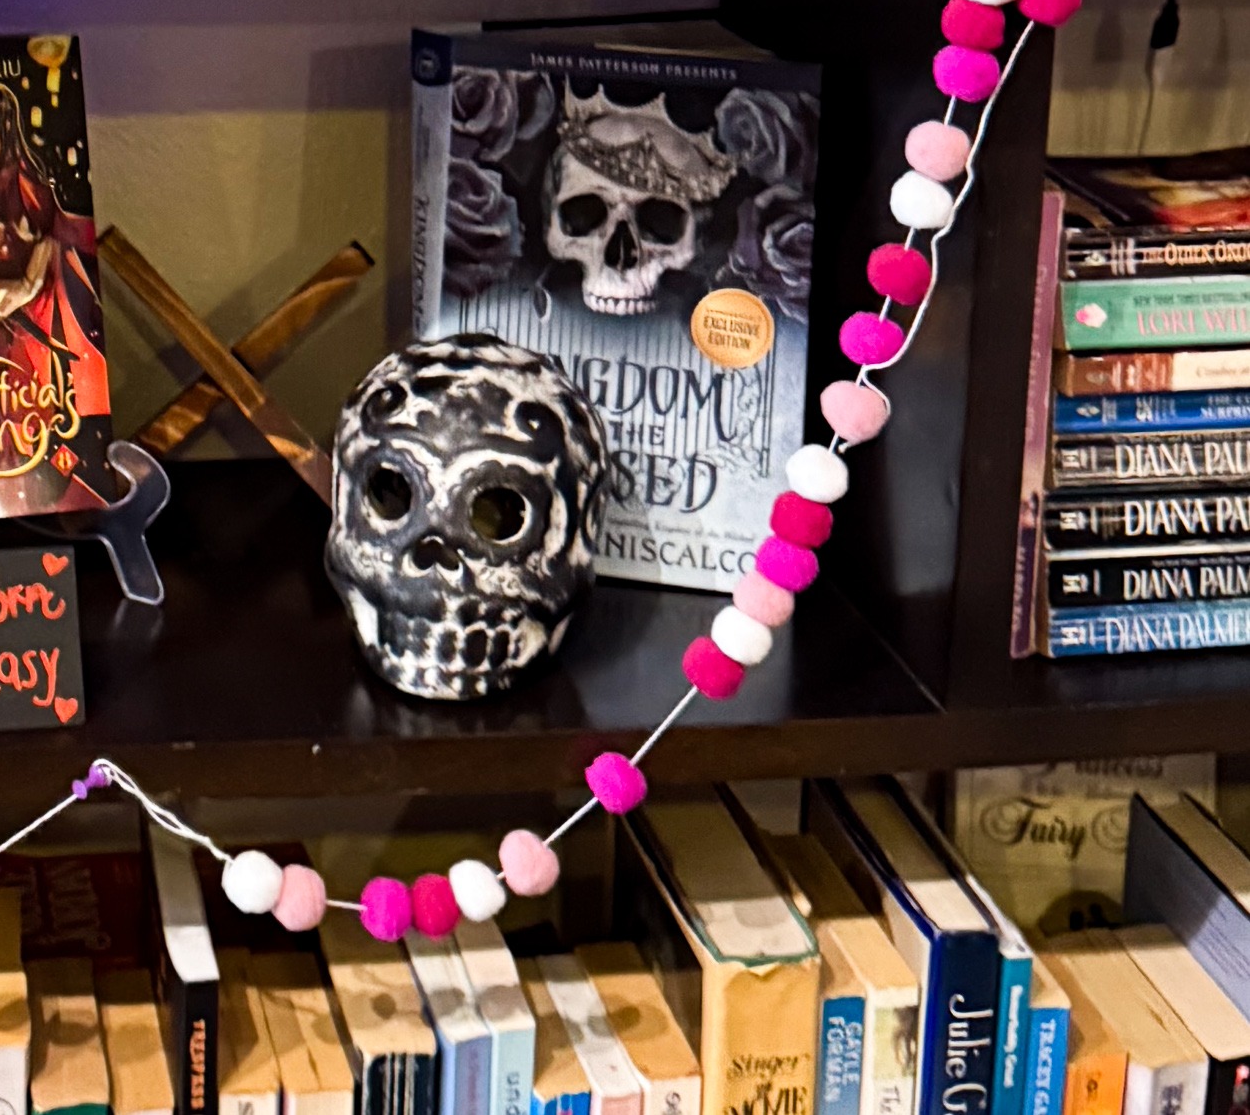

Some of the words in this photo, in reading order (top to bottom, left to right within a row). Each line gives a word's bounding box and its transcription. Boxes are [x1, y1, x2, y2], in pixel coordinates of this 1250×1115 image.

[530, 52, 574, 68] JAMES
[578, 56, 660, 76] PATTERSON
[665, 63, 738, 81] PRESENTS
[1137, 309, 1196, 336] LORI
[608, 419, 666, 447] THE
[1115, 442, 1199, 479] DIANA
[1204, 440, 1250, 476] PAL
[1124, 498, 1211, 537] DIANA
[1216, 495, 1250, 534] PA
[1123, 567, 1194, 602] DIANA
[1105, 614, 1177, 655] DIANA
[842, 1021, 863, 1086] GAYLE
[945, 993, 994, 1080] Julie
[824, 1015, 846, 1103] FORMAN
